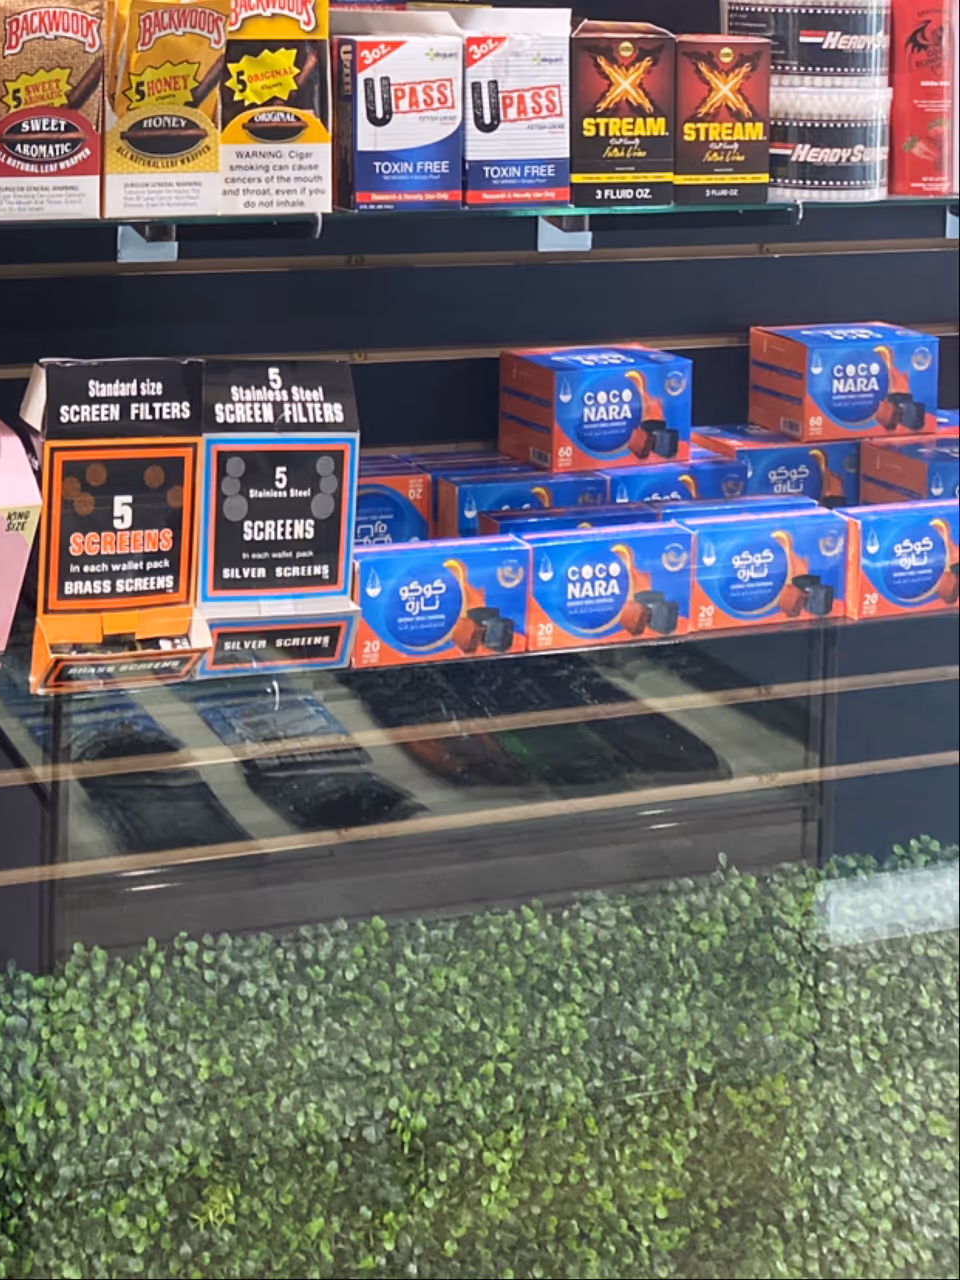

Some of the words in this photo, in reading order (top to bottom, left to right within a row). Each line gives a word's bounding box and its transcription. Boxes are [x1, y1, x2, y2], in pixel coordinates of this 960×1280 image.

[4, 7, 103, 56] BACKWOODS
[138, 8, 227, 51] BACKWOODS
[134, 81, 145, 102] 5
[146, 73, 191, 94] HONEY
[236, 70, 247, 93] 5
[247, 66, 295, 85] ORIGINAL
[21, 119, 67, 132] SWEET
[143, 117, 189, 128] HONEY
[582, 117, 667, 137] STREAM
[683, 122, 765, 141] STREAM
[14, 142, 72, 158] AROMATIC
[288, 150, 313, 161] Cigar
[229, 164, 270, 173] smoking
[272, 164, 290, 172] can
[292, 164, 319, 172] cause
[373, 161, 414, 174] TOXIN
[417, 161, 450, 174] FREE
[483, 166, 521, 178] TOXIN
[524, 165, 556, 177] FREE
[224, 176, 263, 185] cancers
[265, 175, 275, 184] of
[276, 175, 292, 184] the
[293, 175, 323, 183] mouth
[222, 187, 241, 196] and
[275, 188, 297, 196] even
[300, 187, 306, 195] if
[308, 187, 326, 197] you
[595, 190, 602, 200] 3
[604, 189, 634, 200] FLUID
[244, 199, 257, 208] do
[259, 199, 275, 208] not
[268, 367, 282, 389] 5
[833, 363, 880, 377] COCO
[88, 378, 137, 397] Standard
[141, 379, 163, 396] size
[832, 377, 879, 394] NARA
[231, 386, 288, 402] Stainless
[291, 386, 324, 402] Steel
[583, 389, 633, 406] COCO
[60, 404, 120, 423] SCREEN
[130, 401, 191, 421] FILTERS
[214, 403, 275, 424] SCREEN
[284, 403, 345, 423] FILTERS
[583, 405, 632, 423] NARA
[558, 446, 573, 458] 60
[275, 466, 288, 488] 5
[249, 488, 287, 499] Stainless
[289, 488, 311, 498] Steel
[112, 495, 133, 530] 5
[243, 519, 315, 541] SCREENS
[69, 528, 173, 556] SCREENS
[251, 551, 269, 559] each
[271, 550, 293, 559] wallet
[295, 550, 314, 560] pack
[83, 561, 109, 572] each
[111, 560, 143, 572] wallet
[145, 558, 170, 573] pack
[223, 567, 266, 580] SILVER
[275, 564, 329, 578] SCREENS
[567, 562, 621, 581] COCO
[64, 580, 111, 595] BRASS
[115, 575, 174, 594] SCREENS
[398, 579, 447, 600] كوكو
[567, 579, 621, 599] NARA
[699, 605, 715, 617] 20
[537, 623, 553, 636] 20
[224, 640, 266, 650] SILVER
[275, 635, 330, 648] SCREENS
[363, 641, 380, 653] 20
